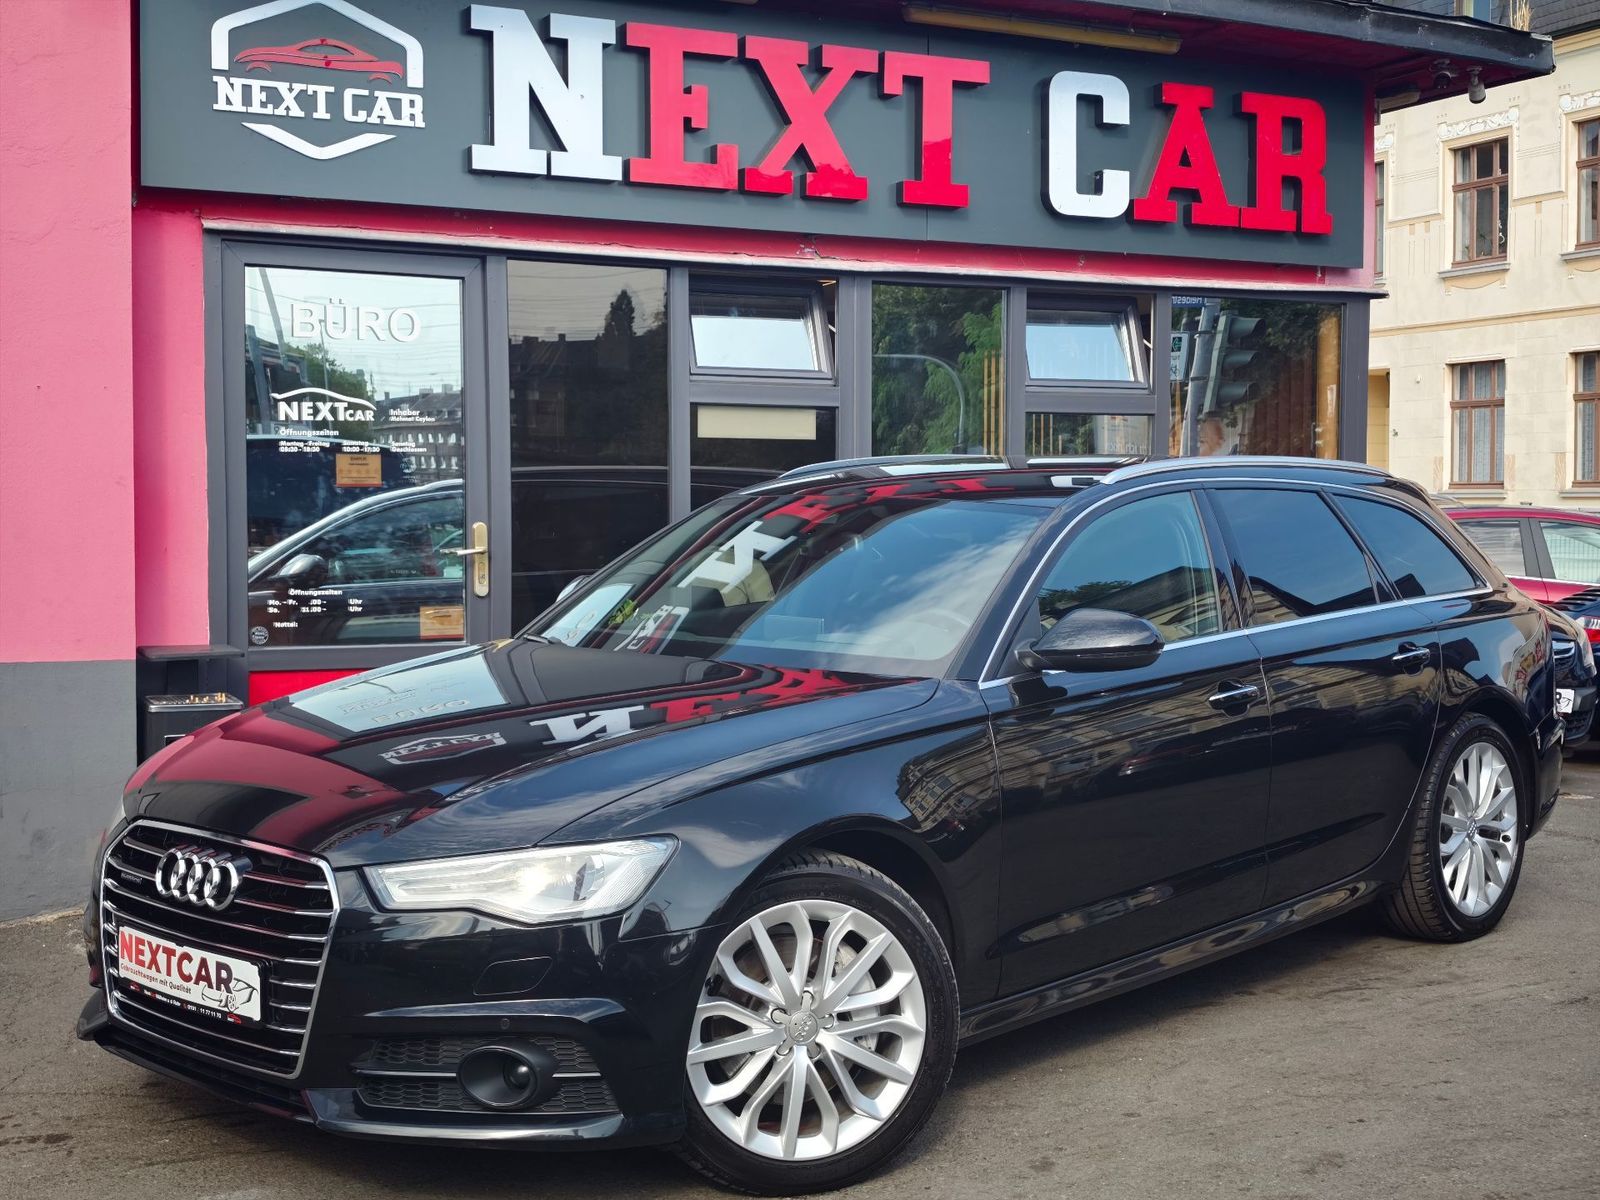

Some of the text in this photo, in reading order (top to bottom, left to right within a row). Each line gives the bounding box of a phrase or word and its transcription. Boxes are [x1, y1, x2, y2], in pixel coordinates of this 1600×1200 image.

[212, 75, 426, 129] NEXT CAR
[470, 4, 1333, 235] NEXT CAR
[291, 297, 422, 342] BÜRO
[389, 408, 420, 416] Inhaber
[280, 426, 339, 437] Öffnungszeiten
[288, 588, 343, 596] Öffnungszeiten
[120, 930, 233, 994] NEXTCAR
[168, 981, 192, 995] Qualität
